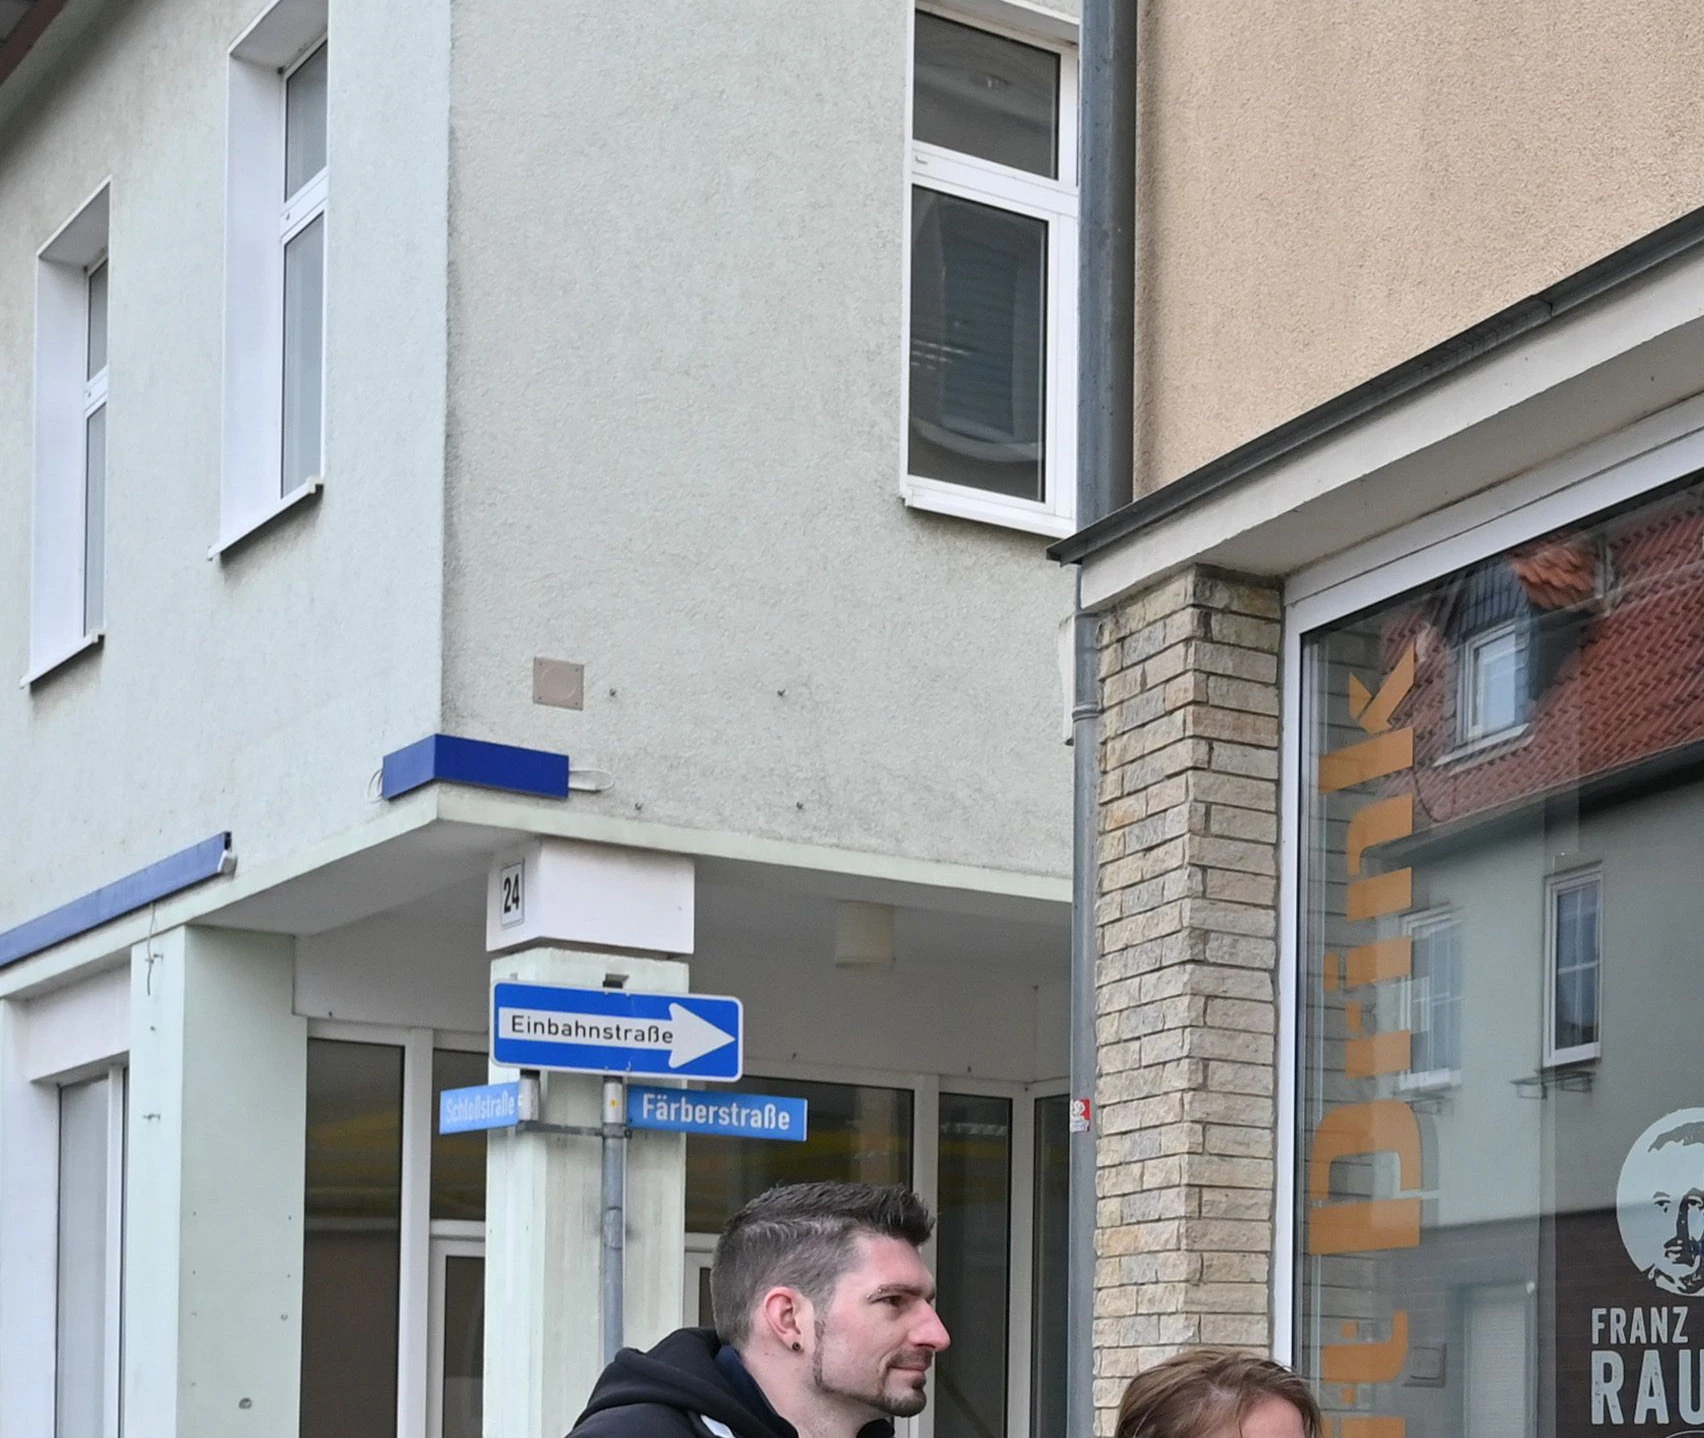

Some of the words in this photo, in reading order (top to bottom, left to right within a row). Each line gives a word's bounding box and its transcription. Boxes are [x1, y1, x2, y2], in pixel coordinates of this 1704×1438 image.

[502, 872, 520, 915] 24
[1308, 641, 1422, 1256] Drink
[511, 1014, 674, 1045] Einbahnstraße
[446, 1090, 515, 1122] Schloßstraße
[642, 1092, 791, 1131] Färberstraße
[1591, 1306, 1689, 1345] FRANZ
